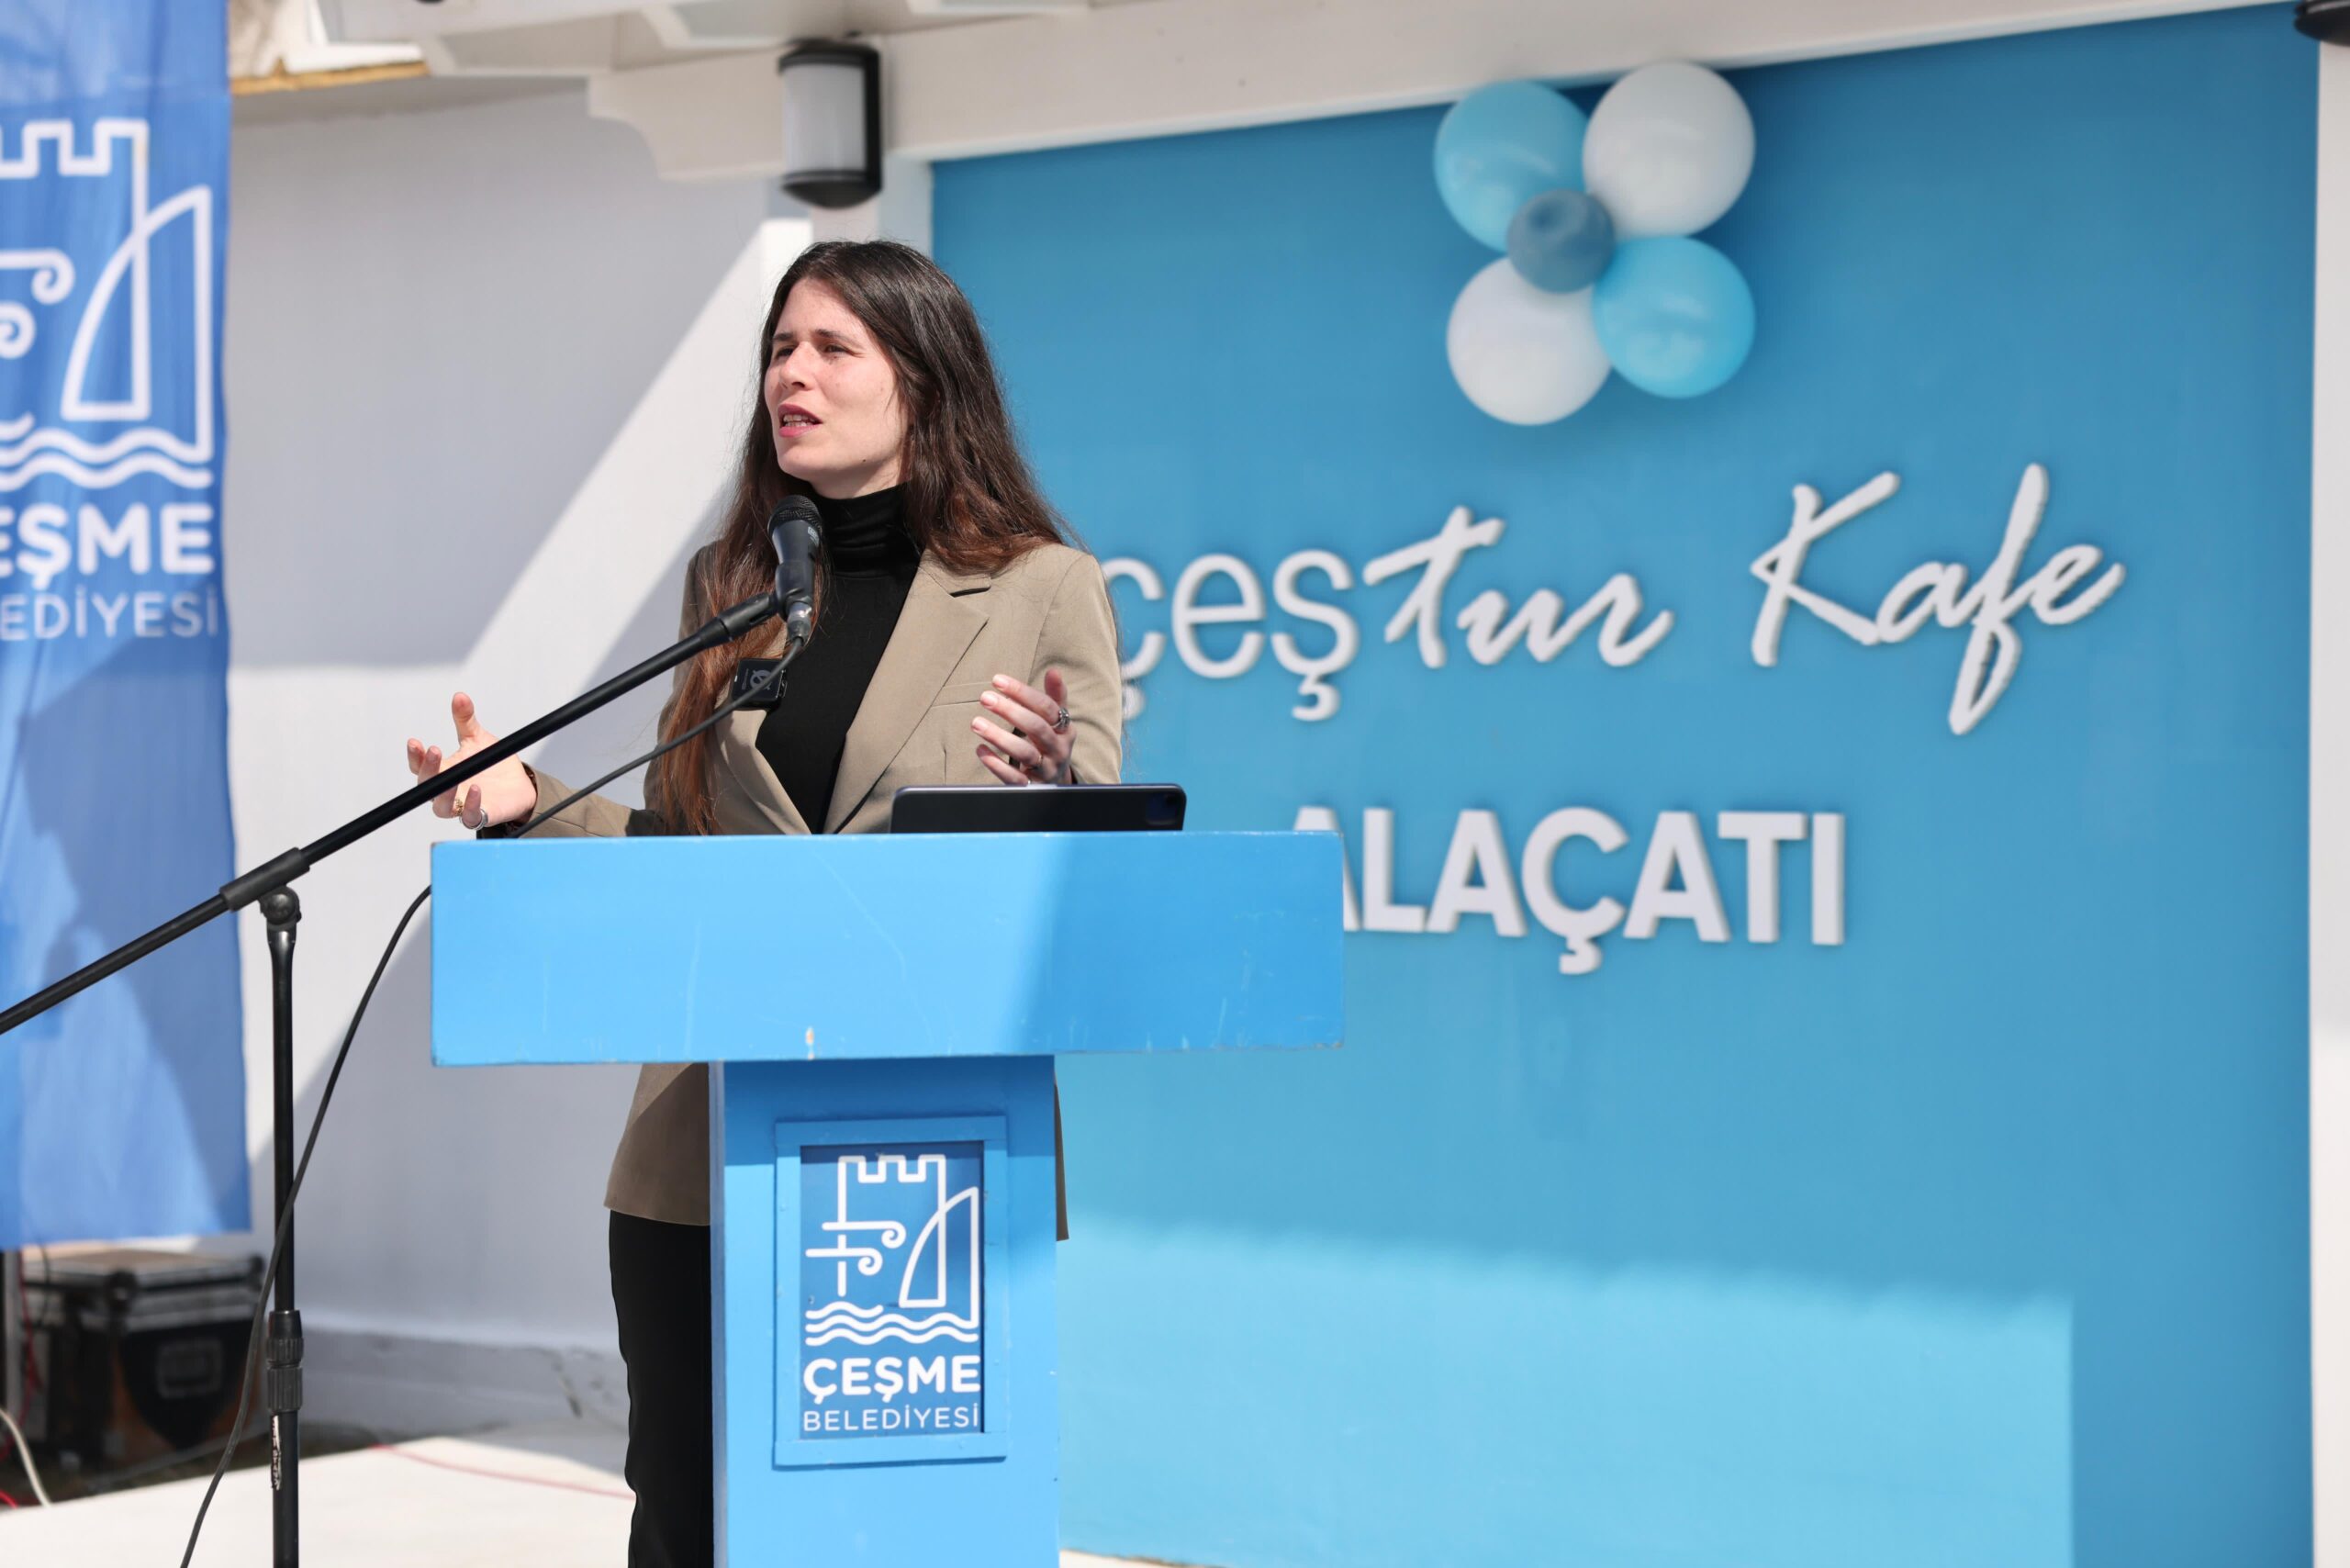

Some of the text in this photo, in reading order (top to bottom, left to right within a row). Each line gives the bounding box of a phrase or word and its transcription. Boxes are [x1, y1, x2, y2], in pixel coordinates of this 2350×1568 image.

[1751, 462, 2126, 735] Kafe
[803, 1355, 981, 1405] ÇEŞME
[803, 1403, 979, 1432] BELEDİYESİ
